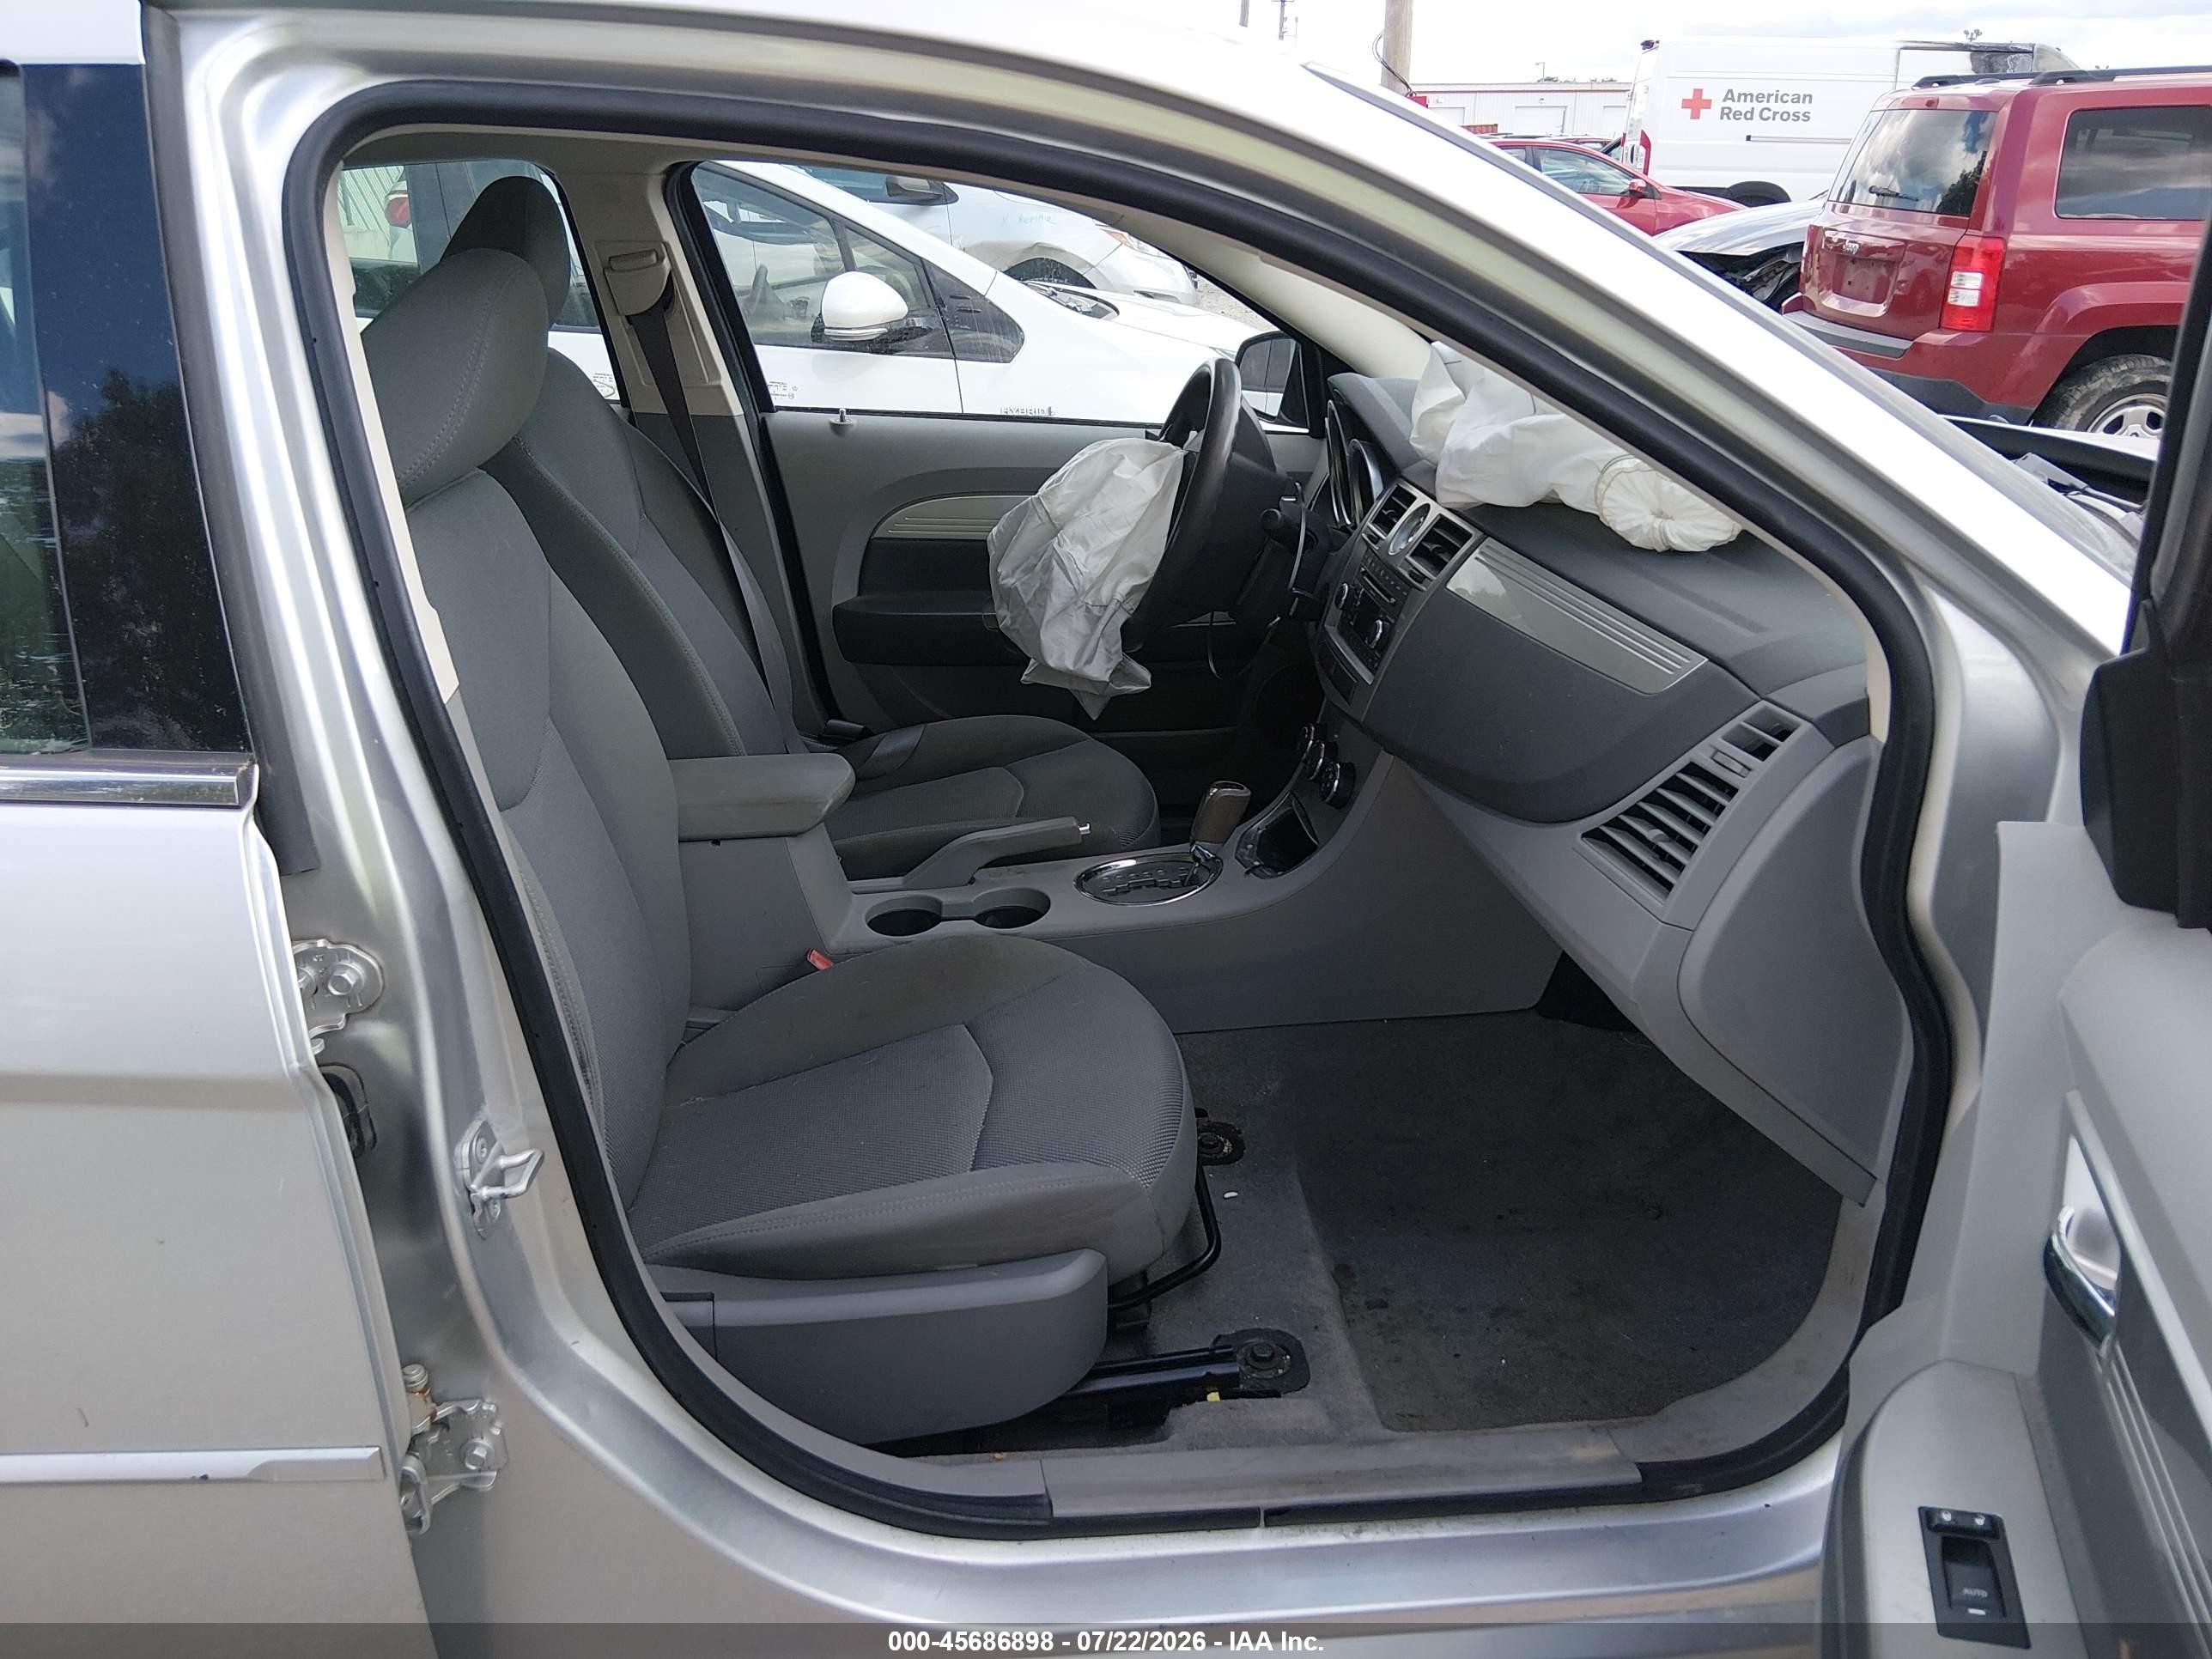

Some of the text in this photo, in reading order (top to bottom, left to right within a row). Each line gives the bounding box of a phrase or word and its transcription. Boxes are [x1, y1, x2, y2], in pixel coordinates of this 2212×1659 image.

[1722, 88, 1813, 104] American
[1719, 106, 1811, 122] Red Cross
[1963, 1588, 1988, 1598] AUTO
